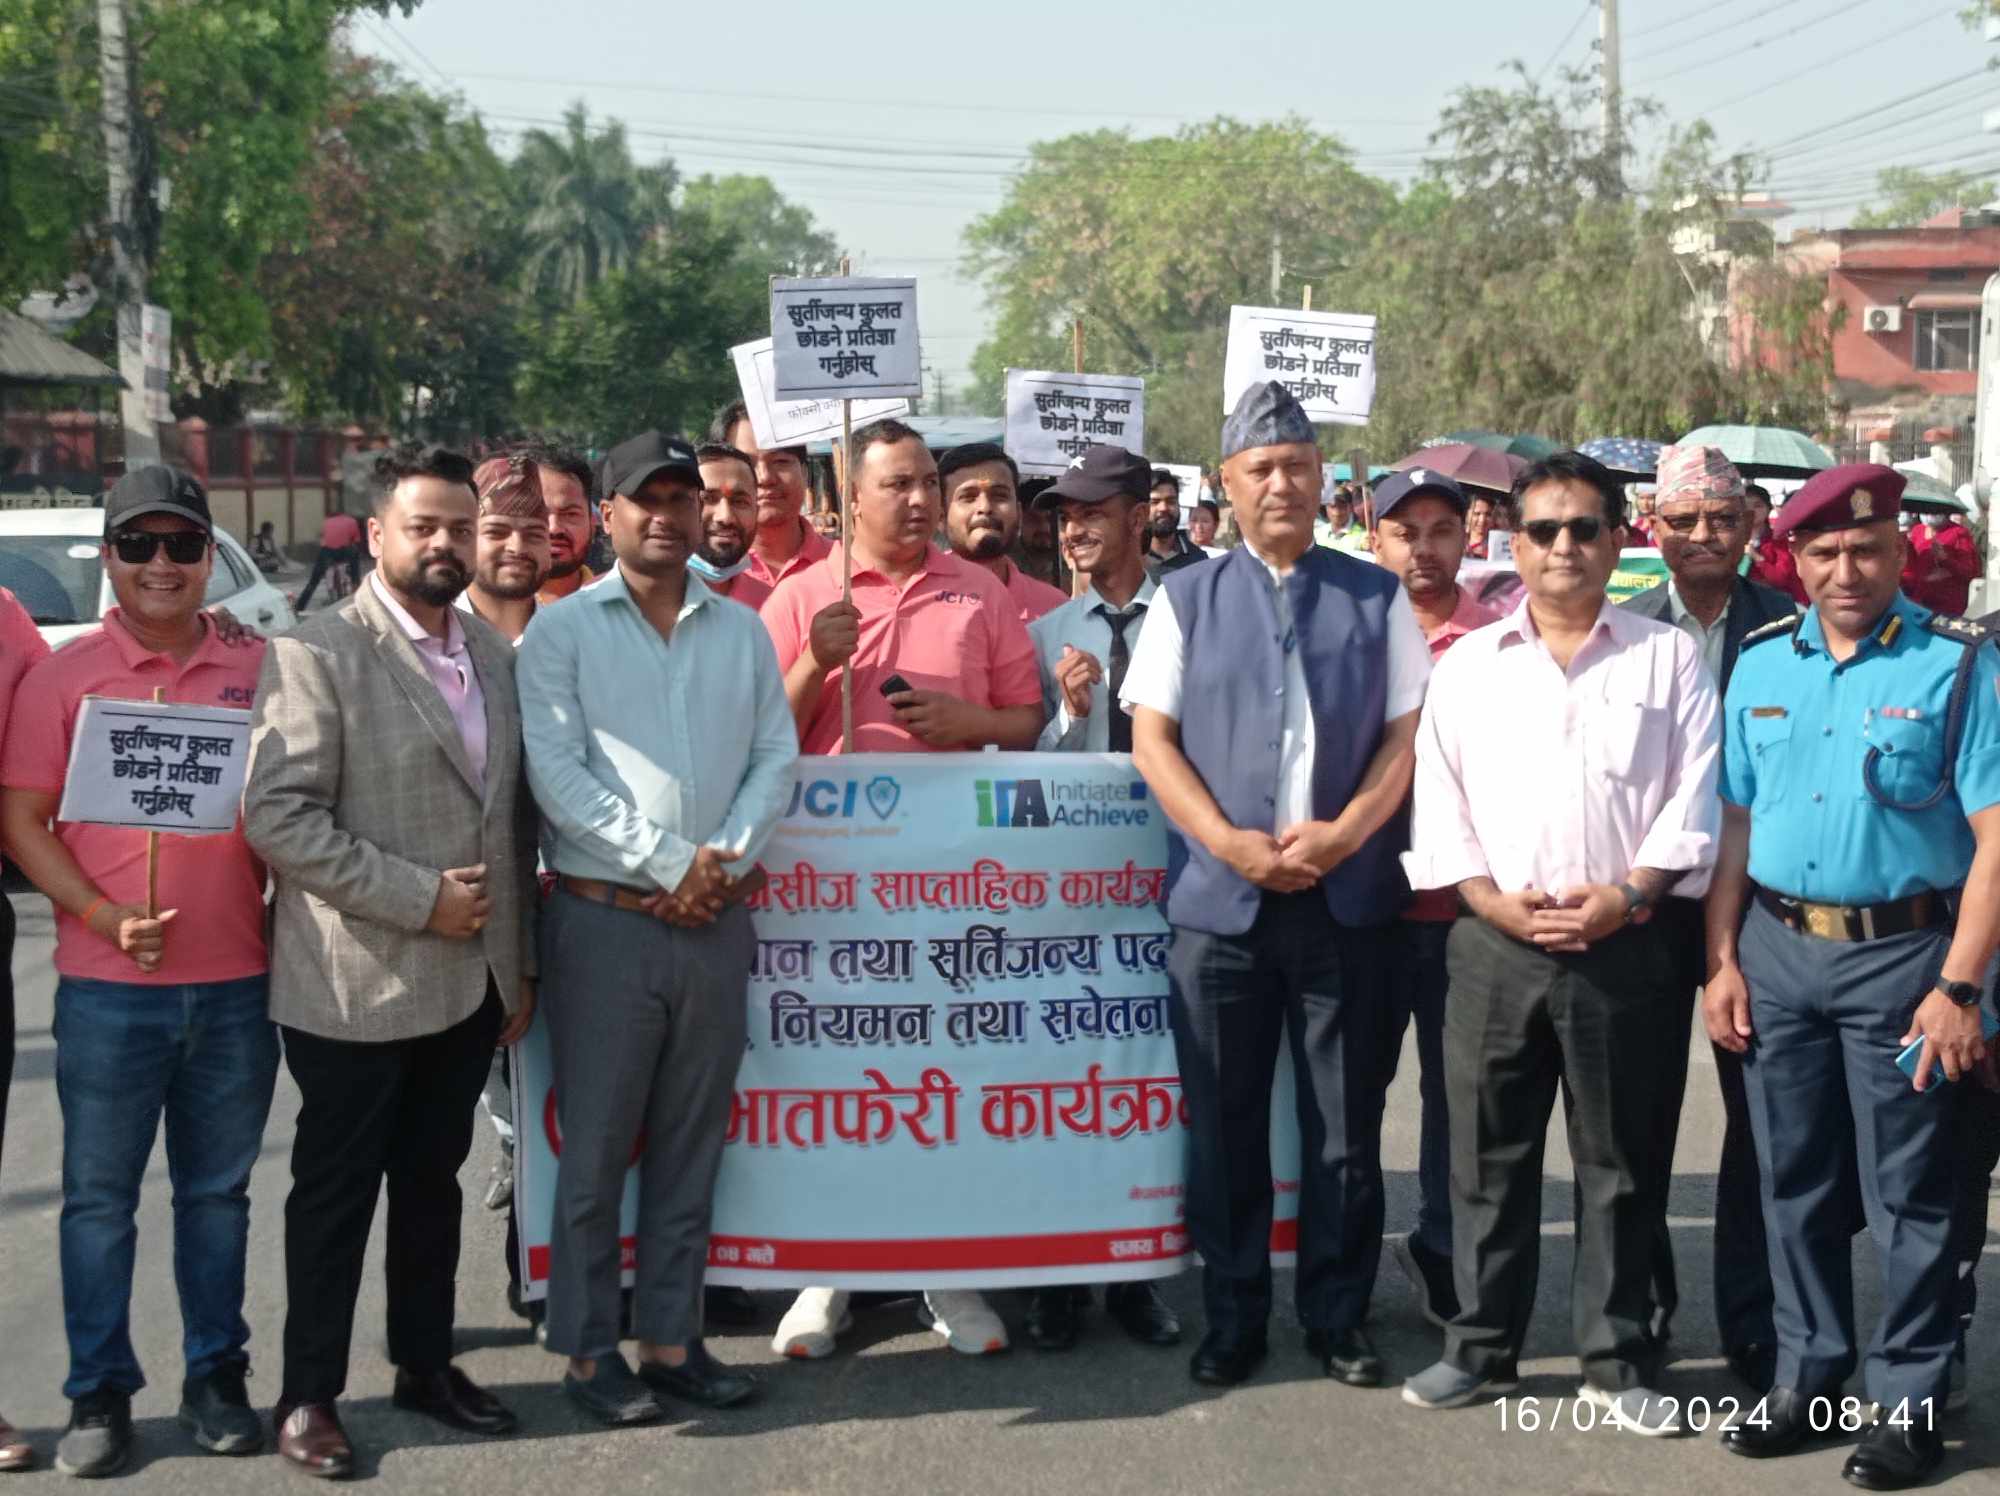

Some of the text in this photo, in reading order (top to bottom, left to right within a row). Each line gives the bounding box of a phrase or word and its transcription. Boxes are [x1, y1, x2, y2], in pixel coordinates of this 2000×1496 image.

[786, 298, 903, 326] सुर्तीजन्य कुलत
[846, 325, 896, 347] प्रतिज्ञा
[818, 350, 879, 378] गर्नुहोस्
[110, 725, 234, 761] सुर्तीजन्य कुलत
[1051, 779, 1130, 801] Initiate
[1052, 803, 1150, 827] Achieve
[871, 858, 1050, 912] साप्ताहिक
[830, 938, 915, 981] तथा
[769, 990, 934, 1046] नियमन
[946, 1001, 1027, 1044] तथा
